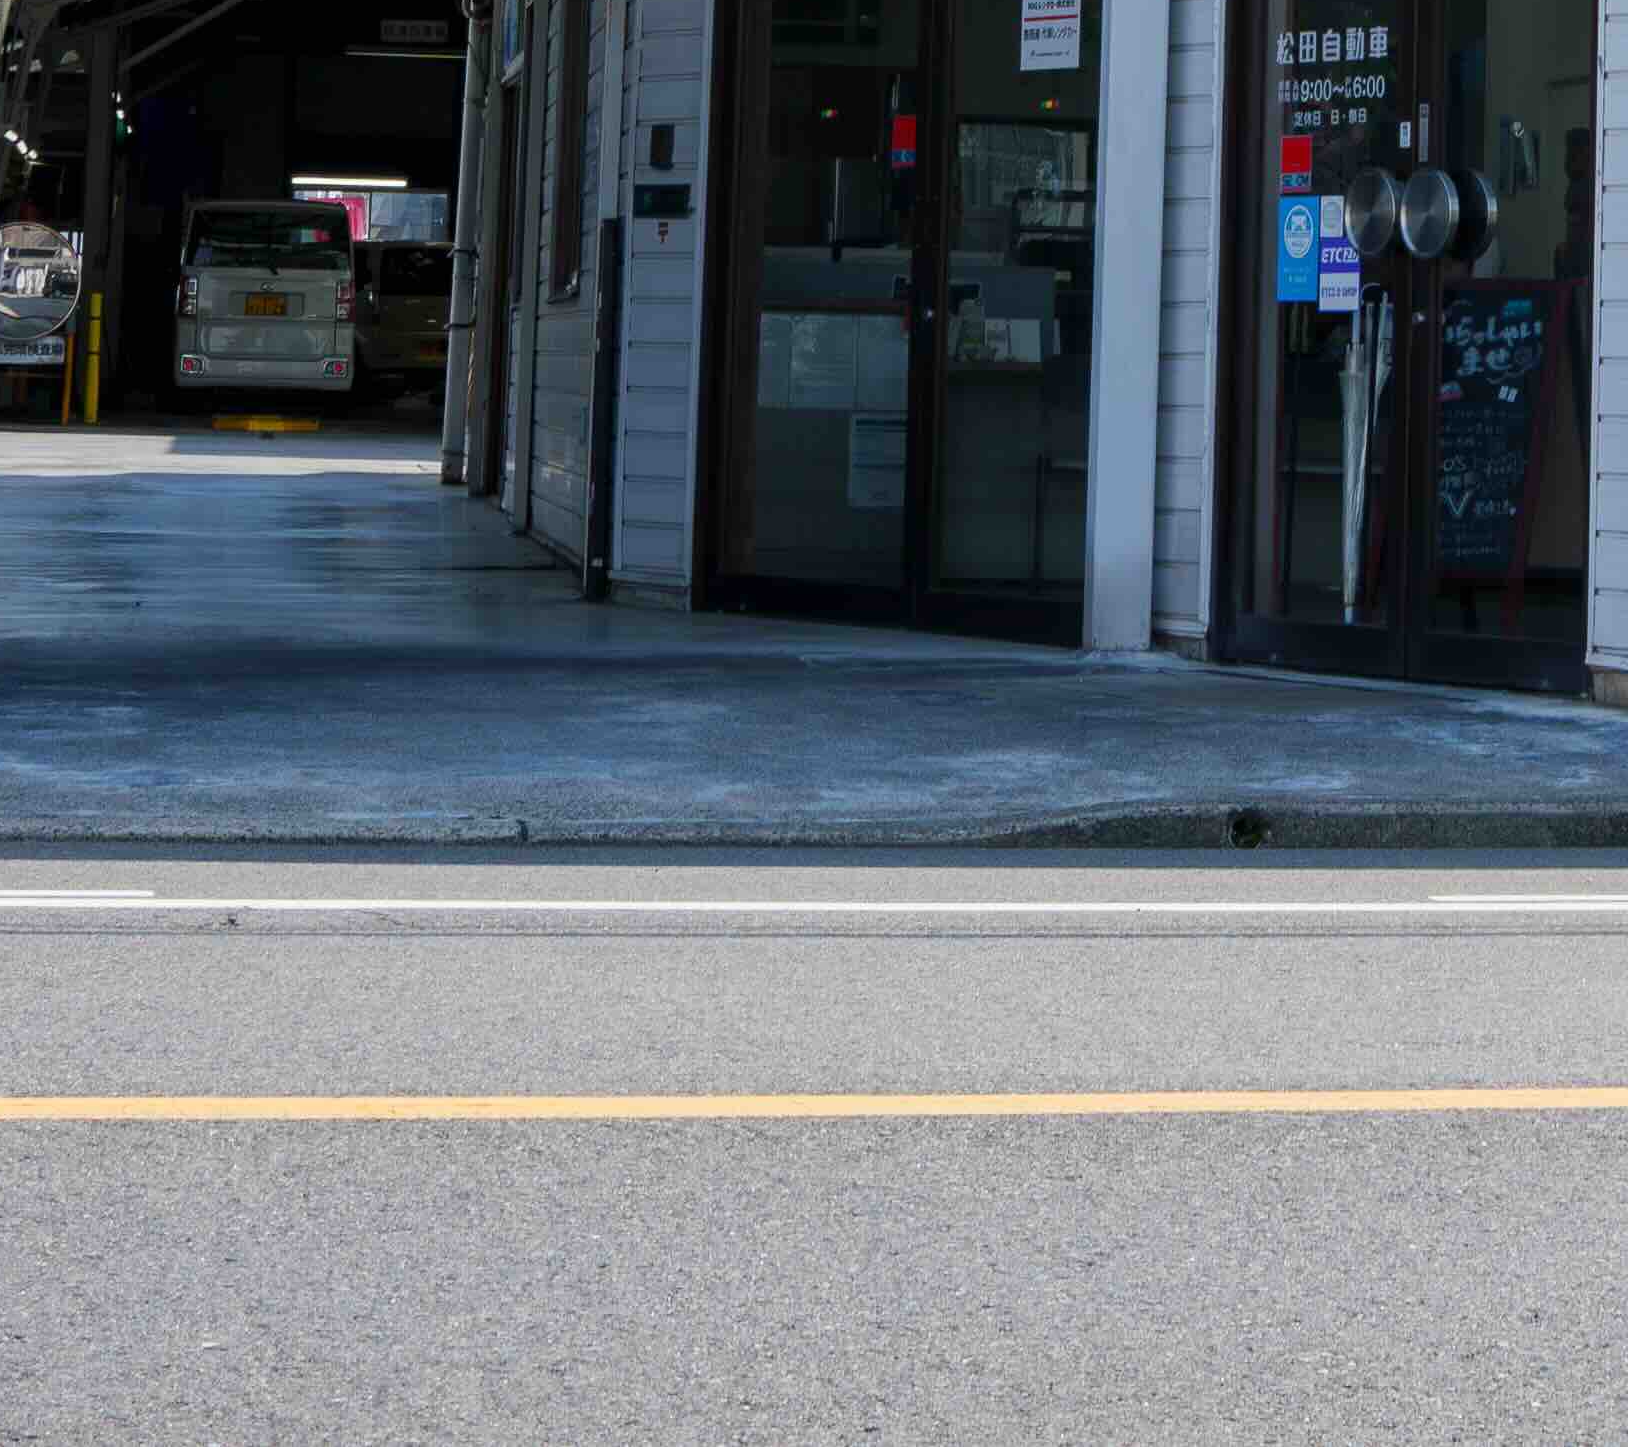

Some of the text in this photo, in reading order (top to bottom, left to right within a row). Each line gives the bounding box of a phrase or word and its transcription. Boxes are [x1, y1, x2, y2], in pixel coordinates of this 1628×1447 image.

[1276, 26, 1389, 65] 松田自動車
